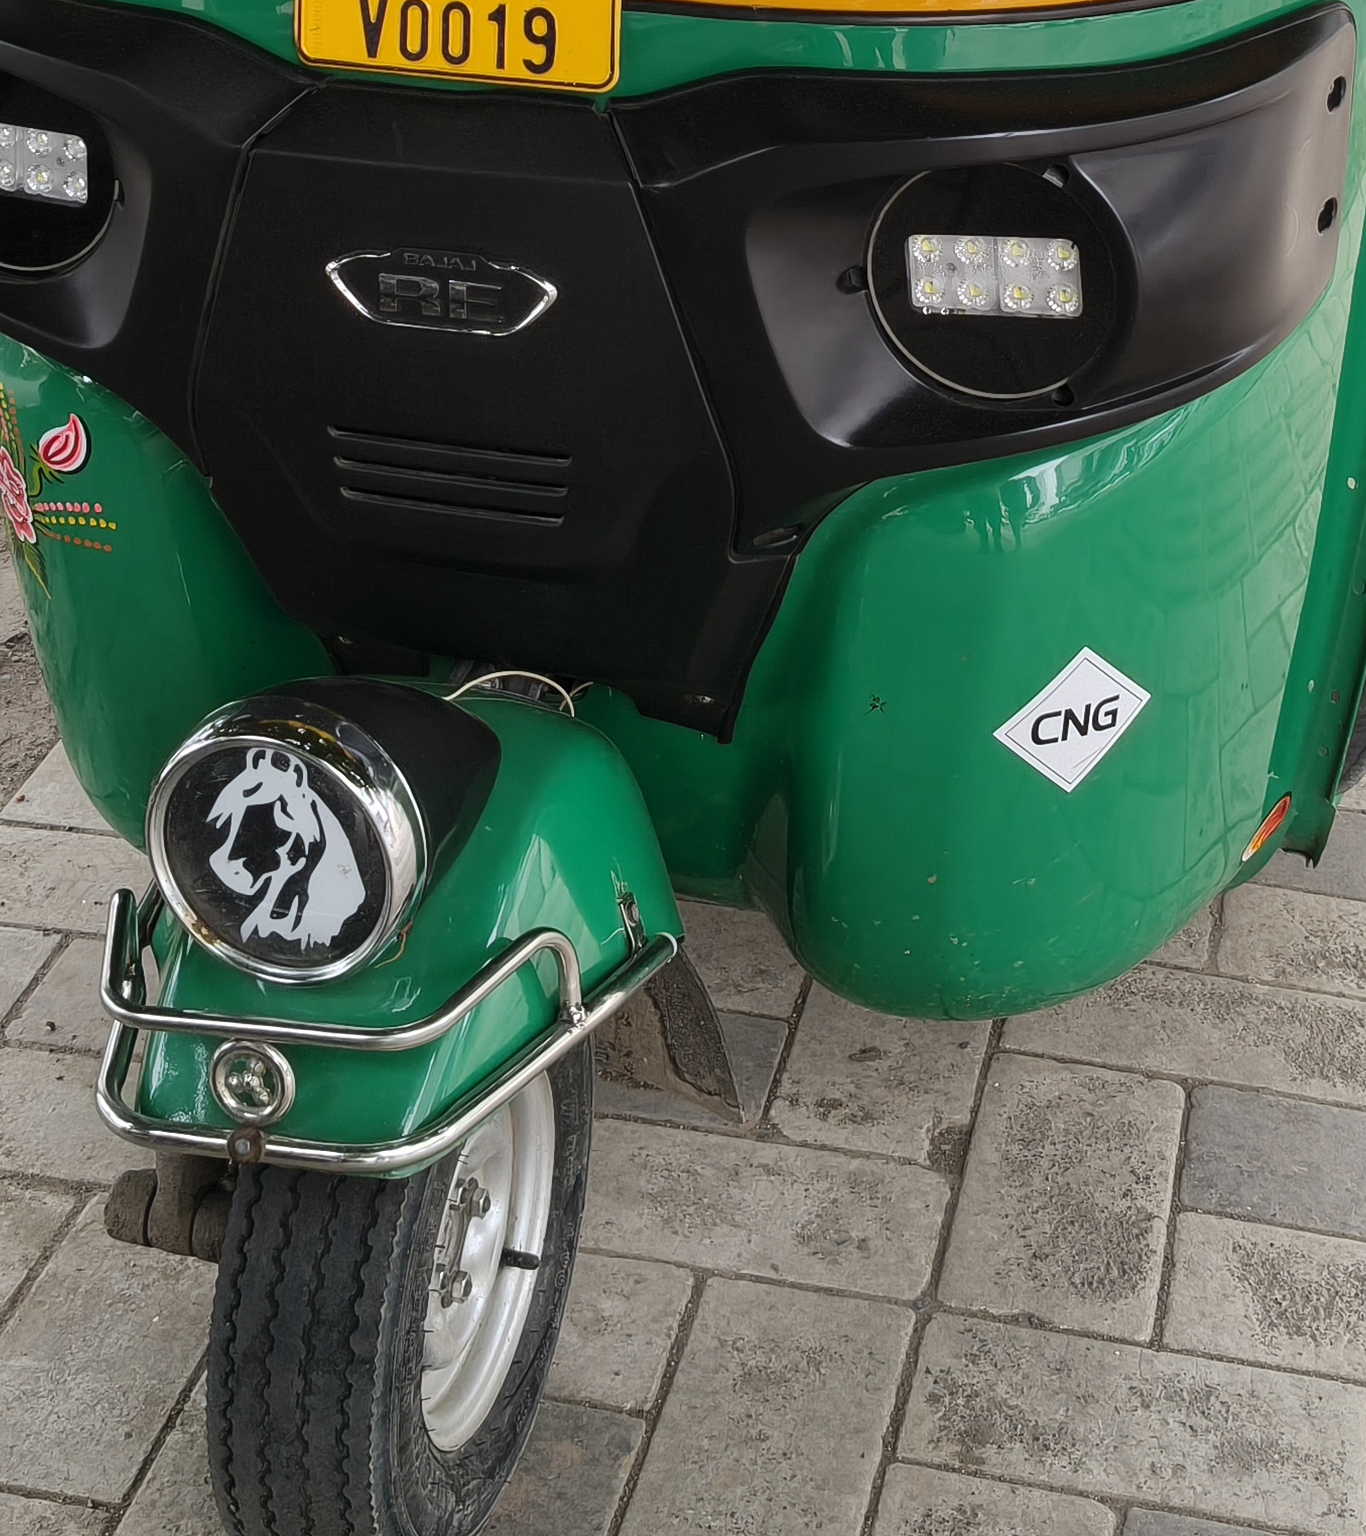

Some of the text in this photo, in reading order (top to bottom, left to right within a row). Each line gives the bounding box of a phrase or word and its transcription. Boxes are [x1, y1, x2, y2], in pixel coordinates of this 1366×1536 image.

[403, 252, 477, 271] BAJAJ
[378, 272, 504, 323] RE
[1030, 694, 1121, 746] CNG
